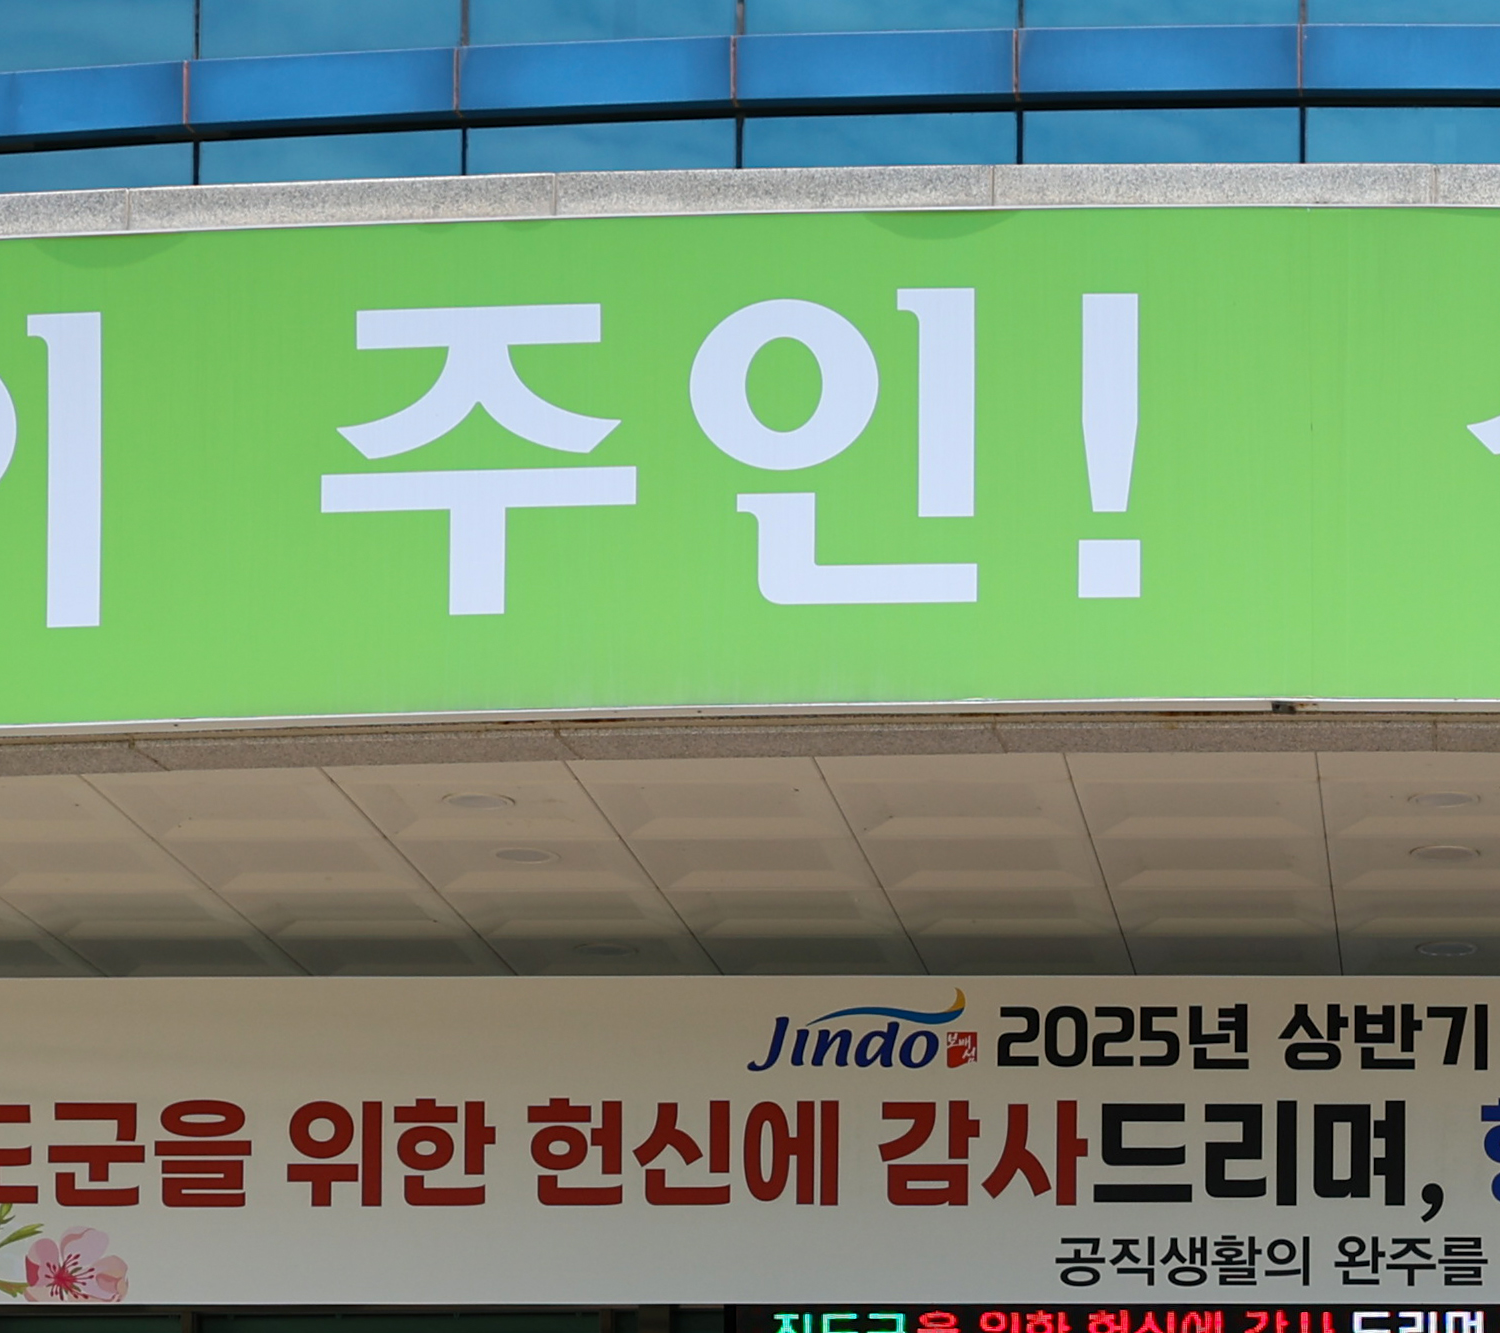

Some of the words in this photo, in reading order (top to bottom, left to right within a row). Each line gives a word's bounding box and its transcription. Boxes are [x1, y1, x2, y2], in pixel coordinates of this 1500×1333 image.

[320, 287, 1141, 616] 주인!
[746, 1015, 940, 1072] Jindo
[996, 1003, 1250, 1070] 2025년
[1277, 1003, 1489, 1071] 상반기
[287, 1098, 496, 1207] 위한
[527, 1097, 840, 1206] 헌신에
[878, 1099, 1444, 1223] 감사드리며,
[1055, 1234, 1310, 1287] 공직생활의
[1334, 1235, 1489, 1287] 완주를
